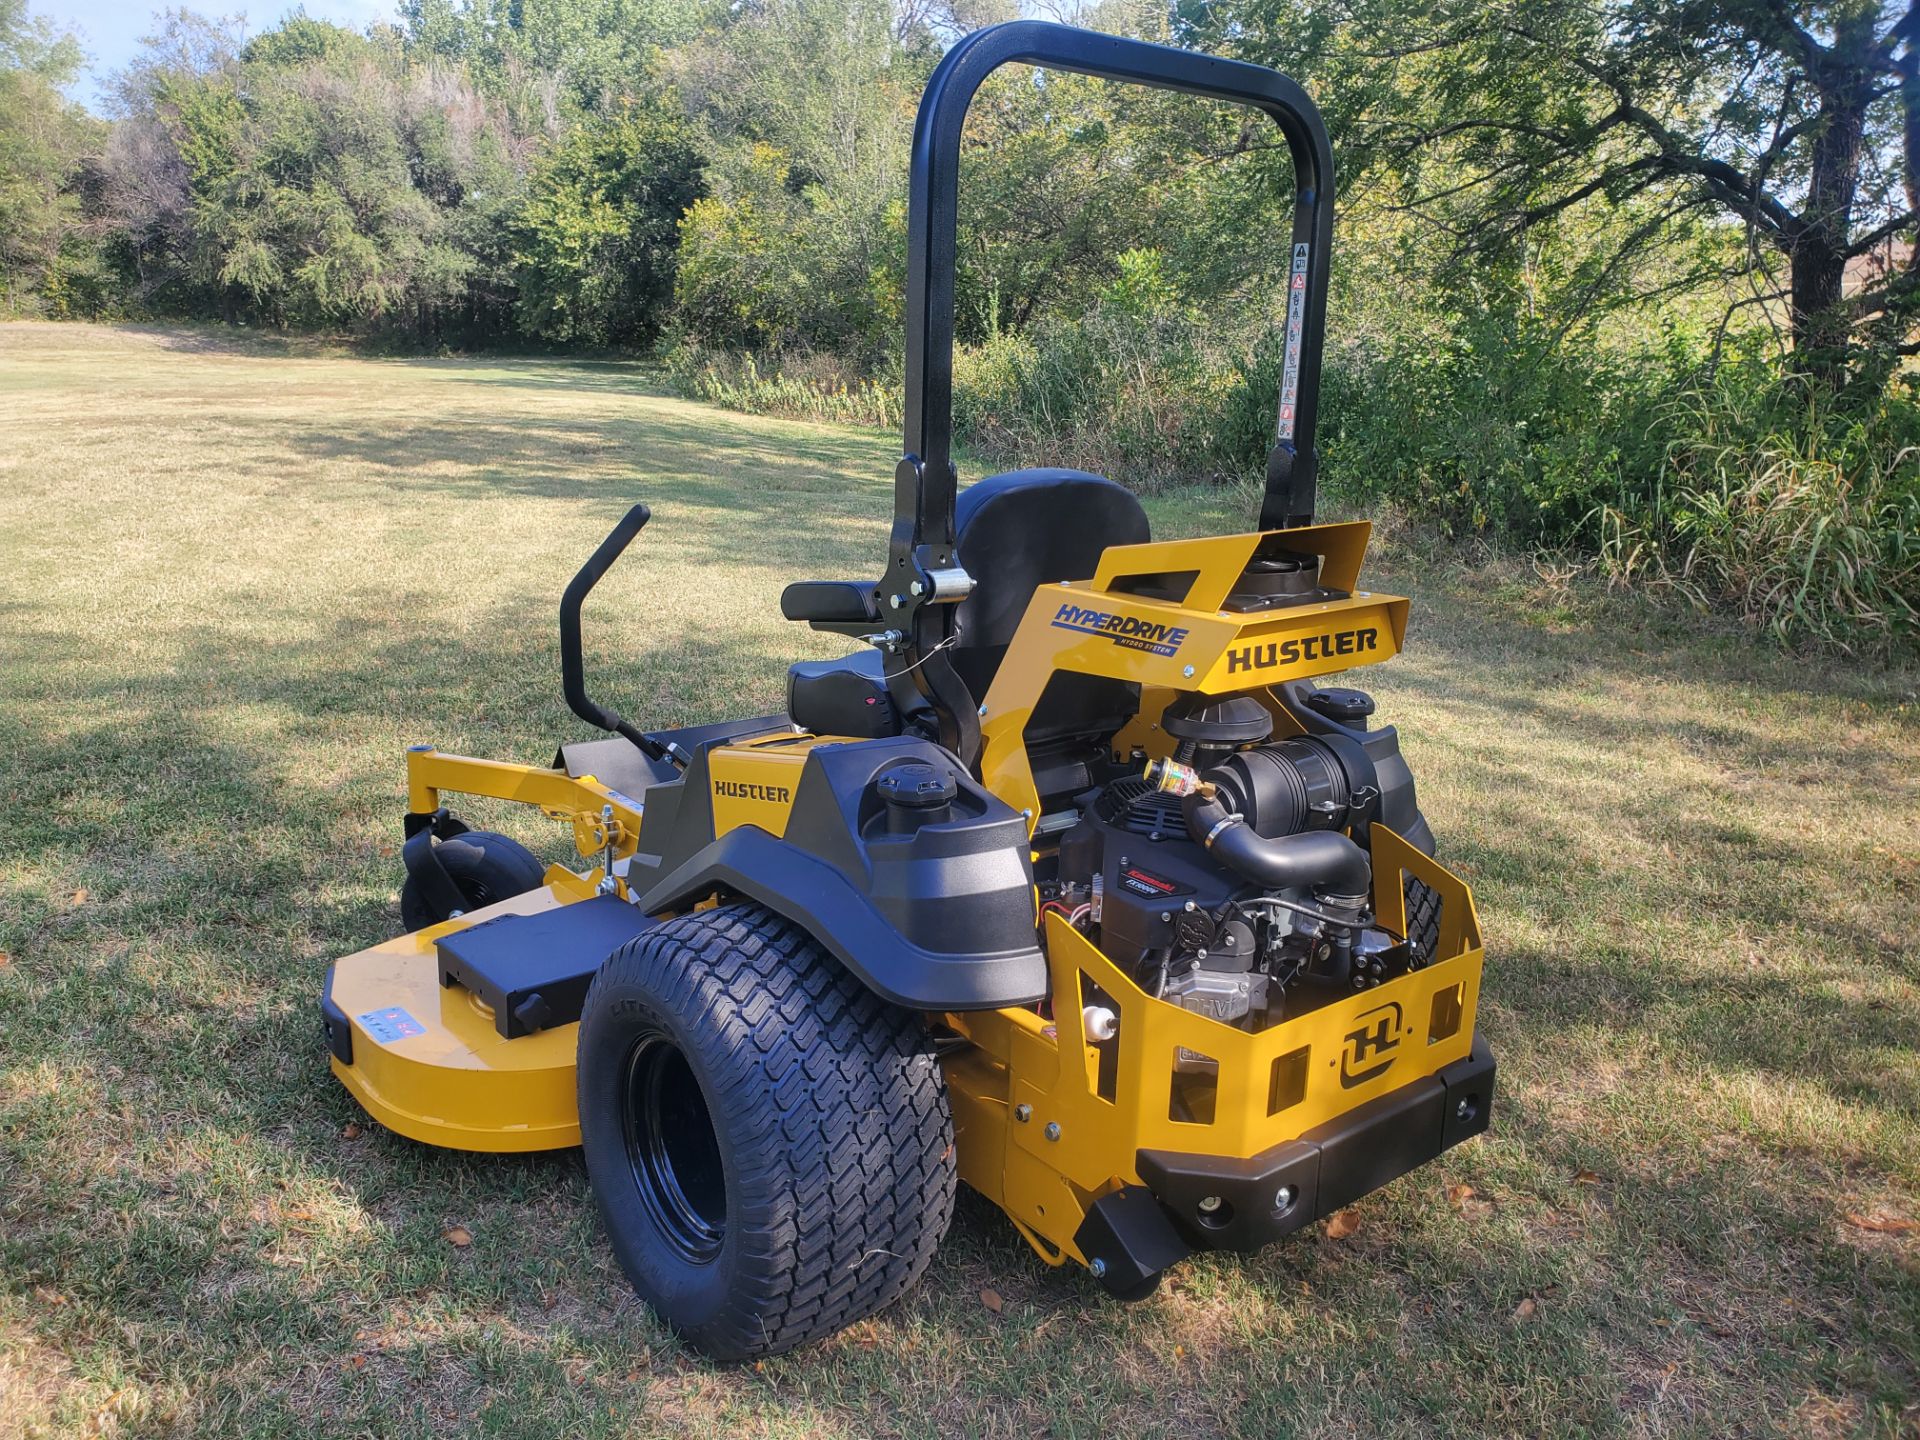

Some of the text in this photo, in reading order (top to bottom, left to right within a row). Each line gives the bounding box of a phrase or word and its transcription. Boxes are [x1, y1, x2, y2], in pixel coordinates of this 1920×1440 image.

[1055, 603, 1190, 646] HYPERDRIVE
[1120, 638, 1171, 654] HYDRO SYSTEM
[1226, 627, 1378, 674] HUSTLER
[715, 780, 790, 804] HUSTLER
